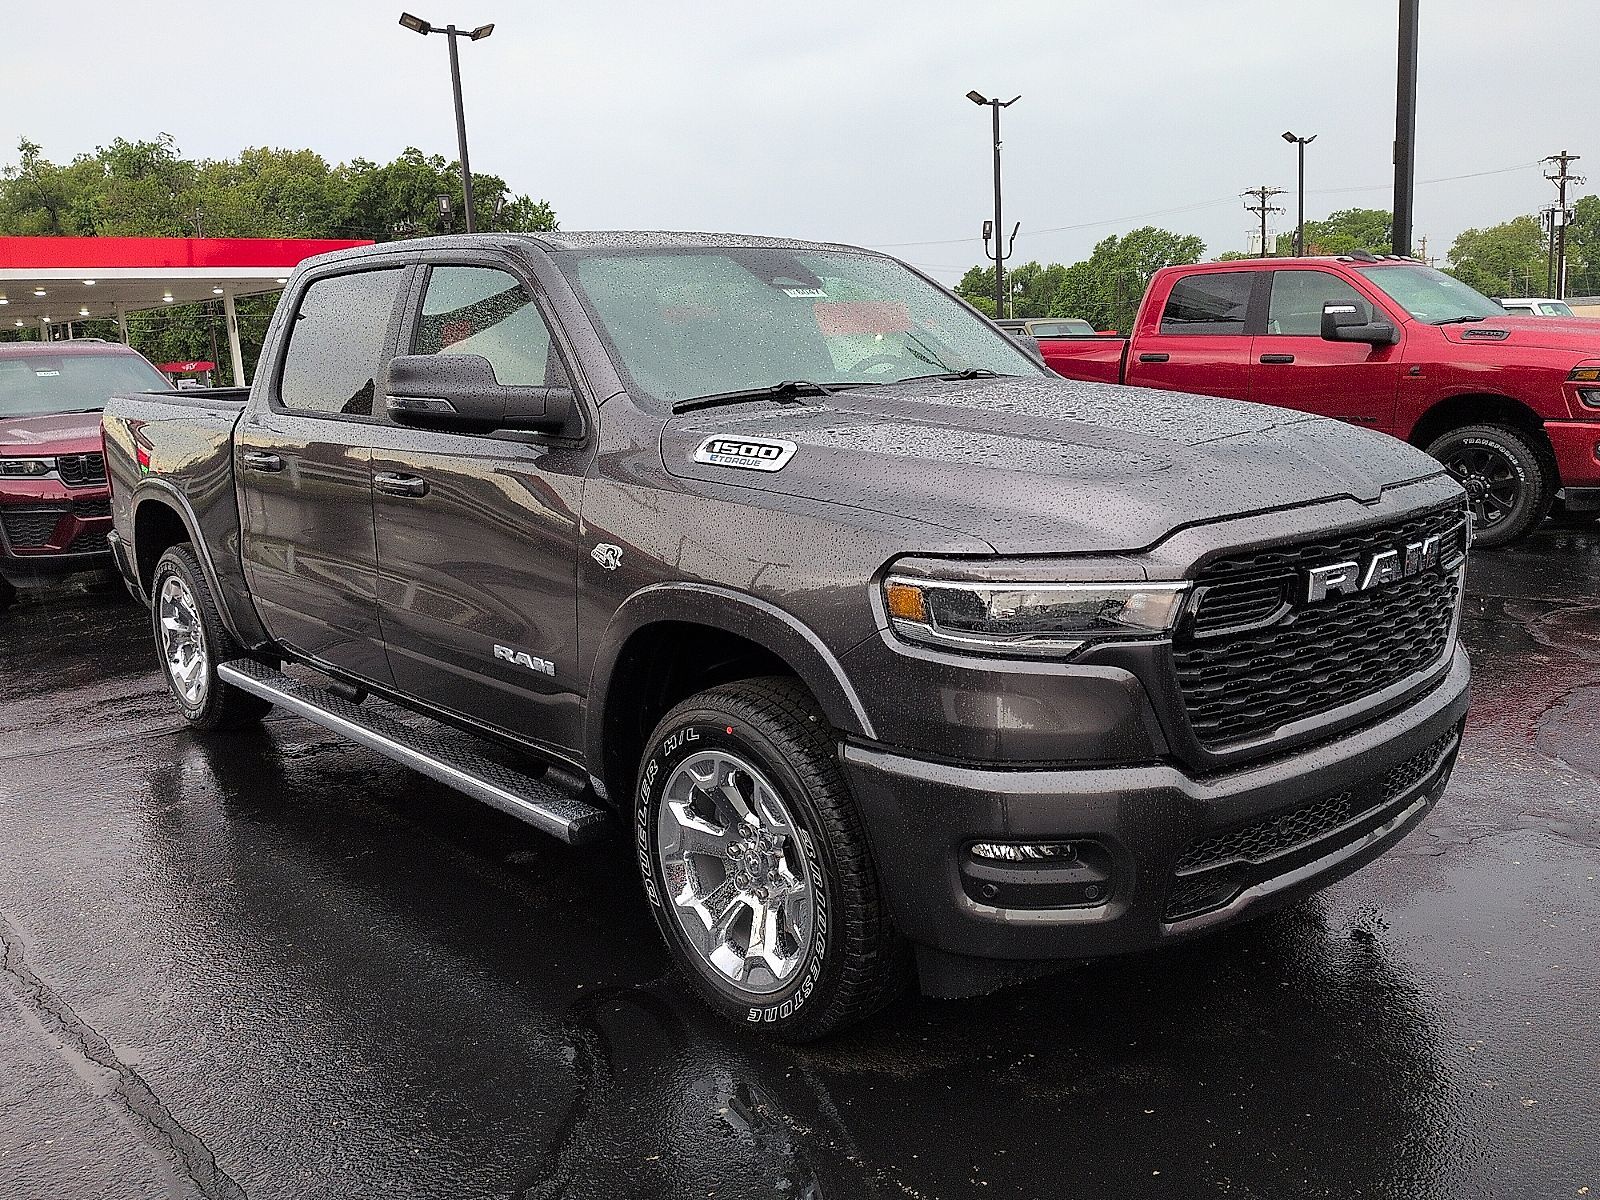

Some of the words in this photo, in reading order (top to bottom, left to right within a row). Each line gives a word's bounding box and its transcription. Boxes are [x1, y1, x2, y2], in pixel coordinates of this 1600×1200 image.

[711, 441, 781, 459] 1500
[1462, 438, 1519, 465] TRANSFORCE
[1308, 534, 1442, 603] RAM
[493, 644, 556, 677] RAM
[637, 758, 661, 907] DUELER
[663, 727, 700, 757] H/L
[746, 828, 828, 1023] BRIDGESTONE
